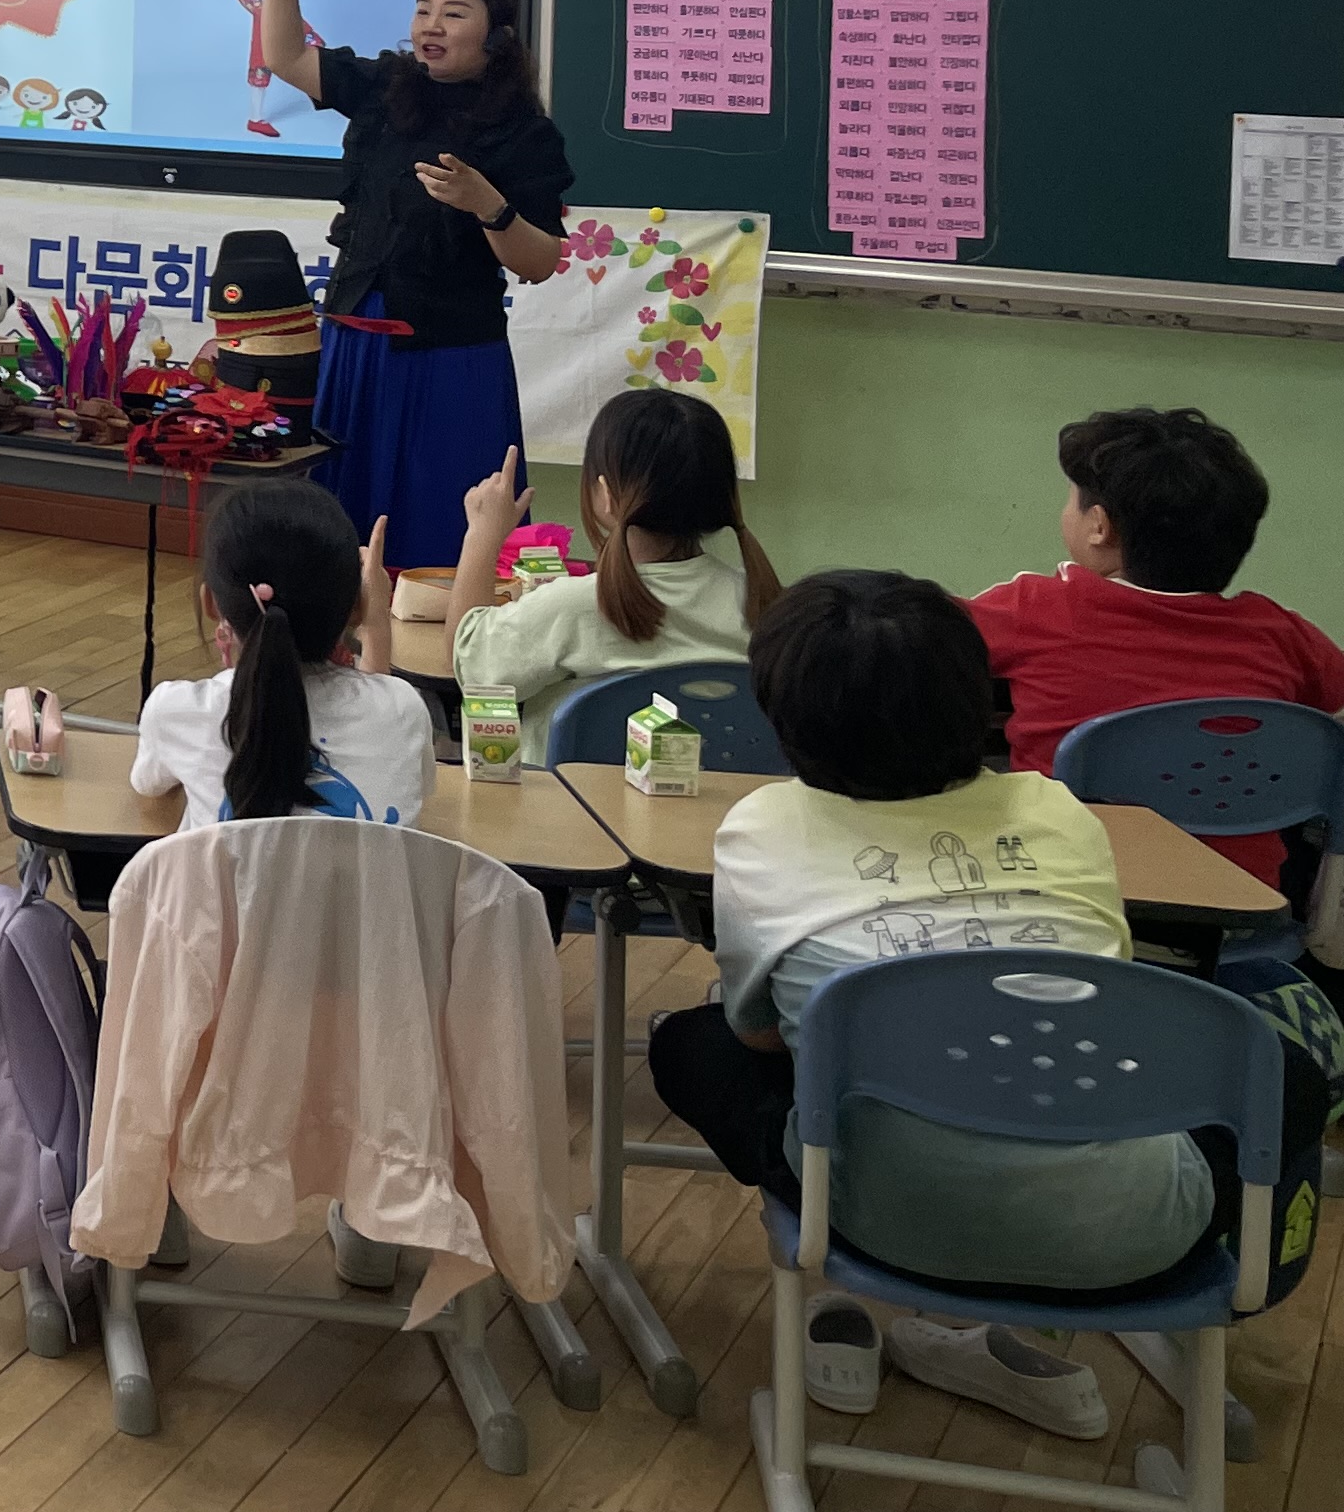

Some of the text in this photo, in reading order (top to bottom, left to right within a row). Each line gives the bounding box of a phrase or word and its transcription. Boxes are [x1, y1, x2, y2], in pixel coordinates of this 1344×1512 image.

[633, 4, 668, 14] 편안하다
[729, 7, 766, 18] 안심된다
[890, 11, 929, 22] 답답하다
[944, 12, 978, 22] 그립다
[634, 26, 669, 36] 감동받다
[729, 29, 765, 40] 따뜻하다
[839, 32, 877, 43] 속상하다
[633, 48, 668, 59] 궁금하다
[732, 52, 764, 63] 신난다
[841, 56, 873, 66] 지친다
[889, 57, 927, 68] 불안하다
[940, 57, 978, 68] 긴장하다
[634, 70, 669, 81] 행복하다
[728, 74, 764, 85] 재미있다
[837, 78, 874, 89] 불편하다
[888, 80, 926, 90] 심심하다
[942, 81, 976, 92] 두렵다
[631, 92, 666, 102] 여유롭다
[679, 94, 714, 105] 기대된다
[728, 96, 764, 107] 평온하다
[839, 100, 871, 111] 외롭다
[838, 147, 870, 157] 괴롭다
[938, 150, 977, 161] 피곤하다
[890, 171, 922, 182] 겁난다
[939, 173, 977, 185] 걱정된다
[915, 241, 947, 253] 무섭다
[27, 235, 210, 323] 다문화
[473, 724, 516, 735] 부산우유
